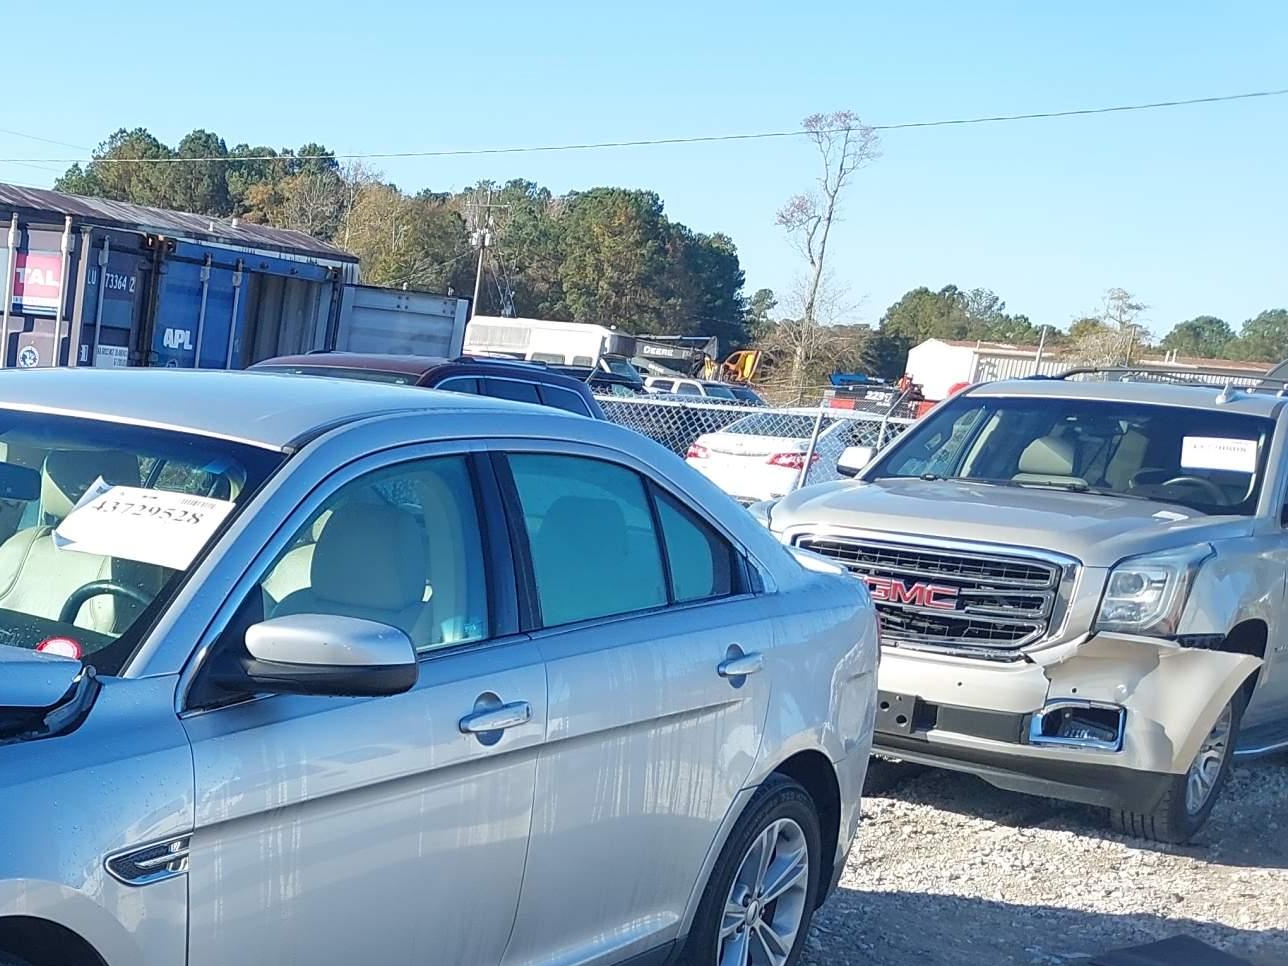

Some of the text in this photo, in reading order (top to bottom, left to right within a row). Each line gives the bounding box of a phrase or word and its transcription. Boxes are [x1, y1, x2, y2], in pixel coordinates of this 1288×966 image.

[14, 266, 60, 289] TAL
[163, 327, 193, 350] APL
[643, 345, 674, 357] DEERE
[92, 500, 205, 525] 43729528
[864, 575, 960, 610] GMC
